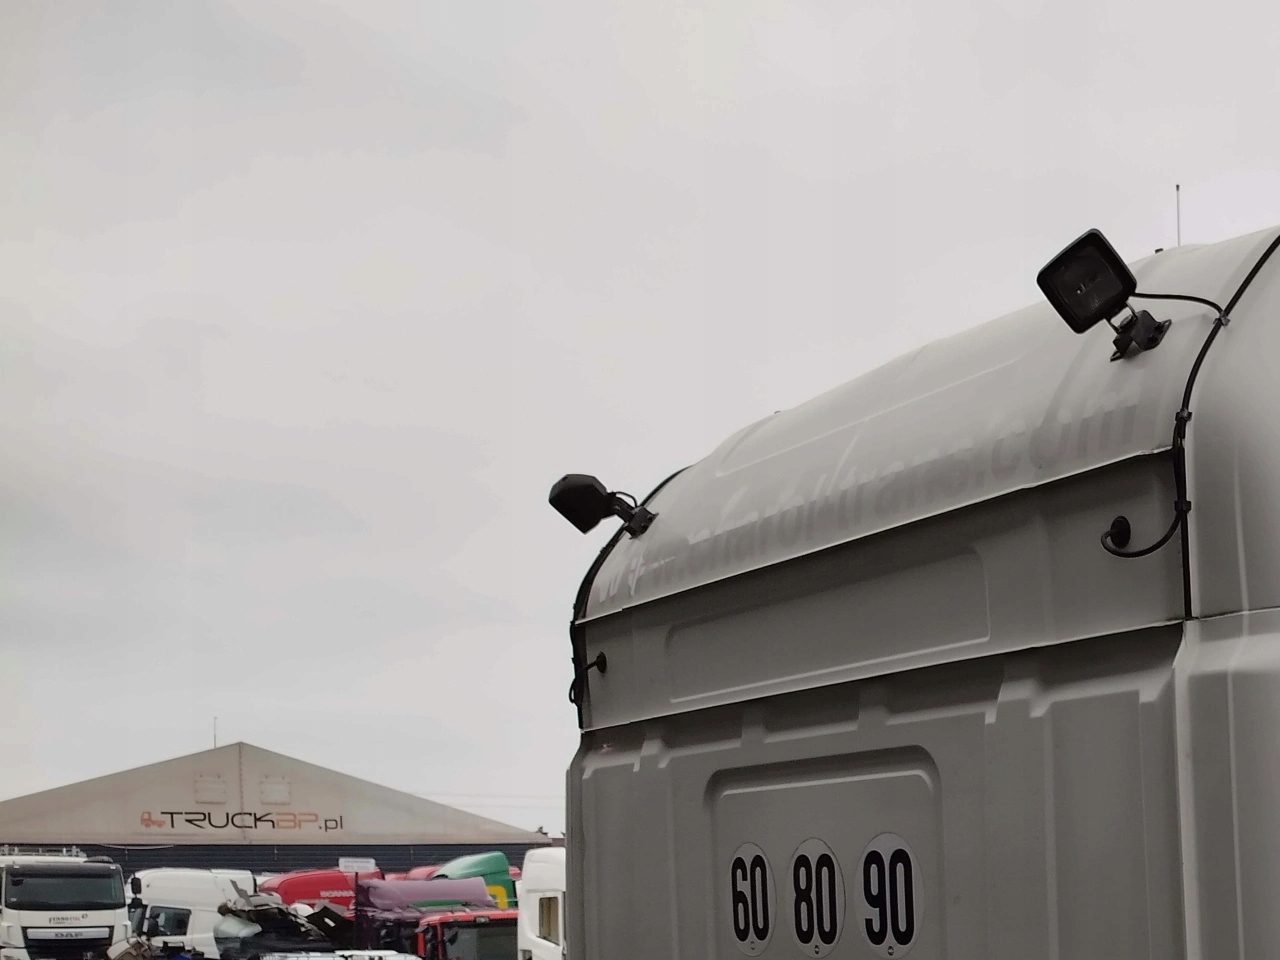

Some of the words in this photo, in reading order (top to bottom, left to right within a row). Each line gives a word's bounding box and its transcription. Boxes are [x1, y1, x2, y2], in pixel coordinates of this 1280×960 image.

[160, 811, 344, 832] TRUCKBP.pl
[731, 854, 770, 942] 60
[793, 853, 838, 945] 80
[862, 848, 915, 946] 90
